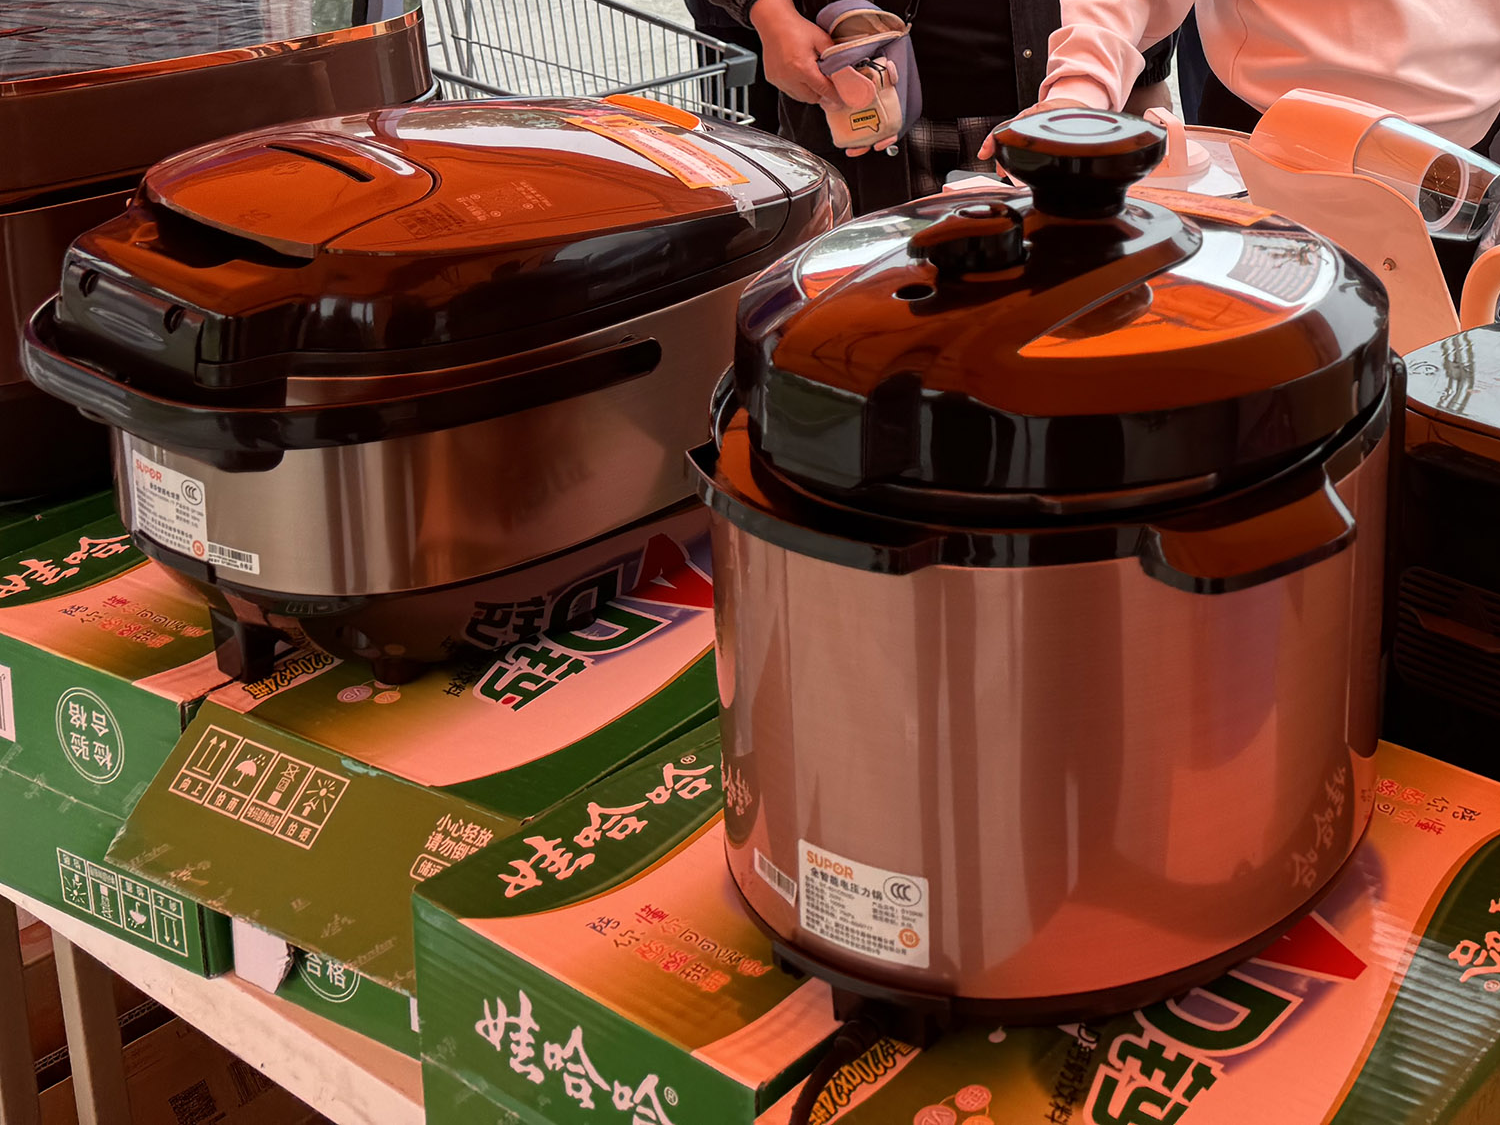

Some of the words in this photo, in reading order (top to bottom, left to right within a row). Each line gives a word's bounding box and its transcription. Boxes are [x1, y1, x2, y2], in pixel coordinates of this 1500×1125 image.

[135, 458, 162, 483] SUPOR
[435, 813, 494, 848] 小心轻放
[498, 762, 714, 898] 娃哈哈
[806, 849, 854, 880] SUPOR
[810, 867, 884, 902] 全智能电压力锅
